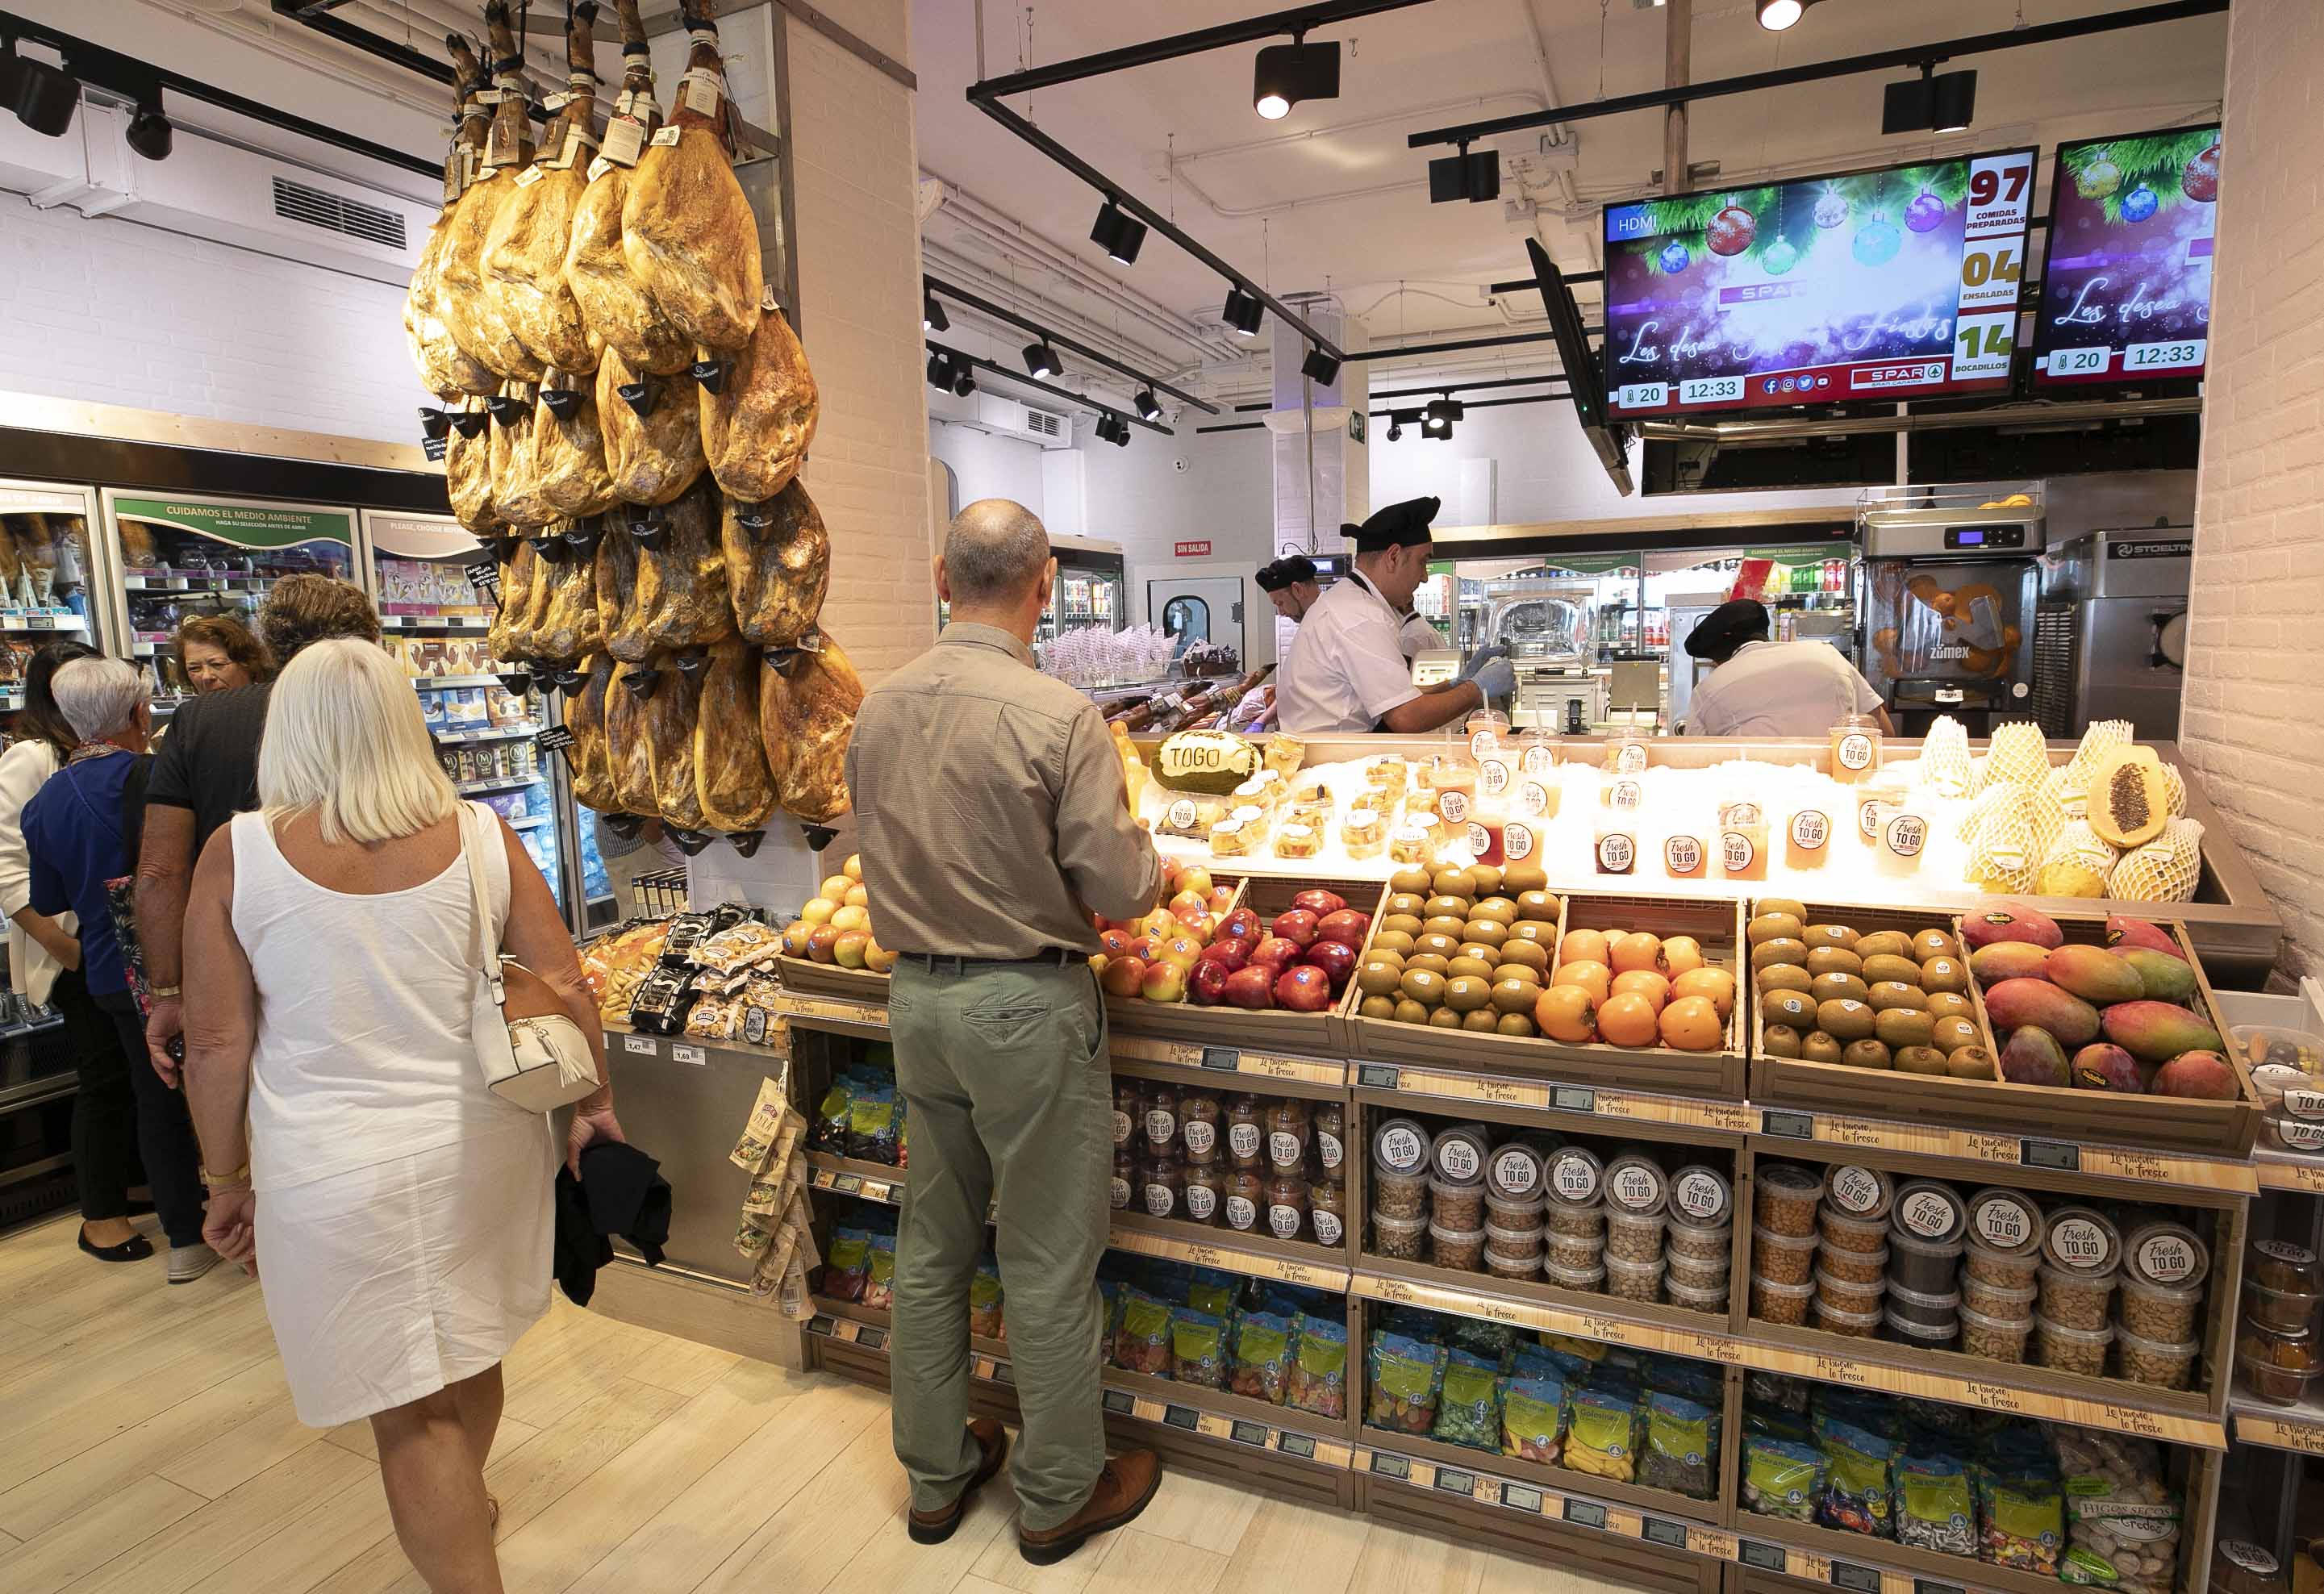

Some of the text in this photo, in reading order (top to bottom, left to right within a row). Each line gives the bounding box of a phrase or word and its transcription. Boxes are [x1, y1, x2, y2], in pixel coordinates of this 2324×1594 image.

[1970, 165, 2030, 207] 97
[1976, 209, 2017, 219] COMIDAS
[1619, 216, 1658, 232] HDMI
[1967, 217, 2026, 229] PREPARADAS
[1962, 249, 2021, 286] 04
[1963, 290, 2014, 300] ENSALADAS
[2055, 277, 2181, 325] Les desea
[1620, 321, 1660, 364] Les
[1959, 324, 2013, 359] 14
[2074, 353, 2101, 369] 20
[2134, 345, 2195, 365] 12:33
[1871, 368, 1924, 381] SPAR
[1955, 362, 2008, 373] BOCADILLOS
[1640, 387, 1660, 403] 20
[1688, 381, 1737, 398] 12:33
[166, 506, 312, 524] CUIDAMOS EL MEDIO AMBIENTE
[1178, 544, 1208, 553] SIN SALIDA
[2134, 544, 2193, 553] STOELTIN
[1846, 739, 1867, 750] Fresh
[1846, 750, 1867, 761] TO GO
[1800, 815, 1823, 828] Fresh
[1897, 820, 1921, 834] Fresh
[1800, 827, 1822, 839] TO GO
[1896, 833, 1921, 845] TO GO
[1605, 839, 1627, 851] Fresh
[1671, 840, 1694, 852] Fresh
[1723, 837, 1744, 850] Fresh
[1607, 851, 1629, 862] TO GO
[1672, 852, 1695, 862] TO GO
[1725, 850, 1745, 861] TO GO
[1724, 1116, 1750, 1129] fresco
[1187, 1125, 1208, 1137] Fresh
[1842, 1130, 1880, 1144] lo fresco
[2293, 1125, 2309, 1138] TO
[1190, 1133, 1211, 1145] TO GO
[1387, 1132, 1412, 1147] Fresh
[1390, 1145, 1415, 1158] TO GO
[1447, 1144, 1472, 1158] Fresh
[1980, 1147, 1988, 1158] lo
[1990, 1148, 2019, 1161] fresco
[1448, 1156, 1472, 1170] TO GO
[1503, 1156, 1529, 1170] Fresh
[1561, 1162, 1588, 1177] Fresh
[1504, 1170, 1529, 1183] TO GO
[1621, 1170, 1649, 1186] Fresh
[2126, 1164, 2169, 1179] lo fresco
[1562, 1176, 1588, 1189] TO GO
[1687, 1177, 1717, 1196] Fresh
[1845, 1168, 1873, 1195] Fresh
[1623, 1185, 1650, 1198] TO GO
[1840, 1180, 1869, 1205] TO GO
[1687, 1191, 1714, 1208] TO GO
[1272, 1208, 1294, 1220] Fresh
[1915, 1195, 1948, 1219] Fresh
[1987, 1204, 2022, 1223] Fresh
[1274, 1218, 1295, 1229] TO GO
[1911, 1206, 1944, 1230] TO GO
[1988, 1219, 2021, 1237] TO GO
[2062, 1224, 2097, 1241] Fresh
[2064, 1240, 2099, 1255] TO GO
[2149, 1240, 2183, 1257] Fresh
[2151, 1255, 2186, 1270] TO GO
[1829, 1368, 1865, 1383] lo fresco
[1968, 1381, 1977, 1395] Lo
[1980, 1393, 2020, 1409] lo fresco
[2106, 1405, 2117, 1419] Lo
[2120, 1418, 2163, 1434] lo fresco
[2083, 1503, 2170, 1517] HIGOS SECOS
[1709, 1541, 1732, 1555] fresco
